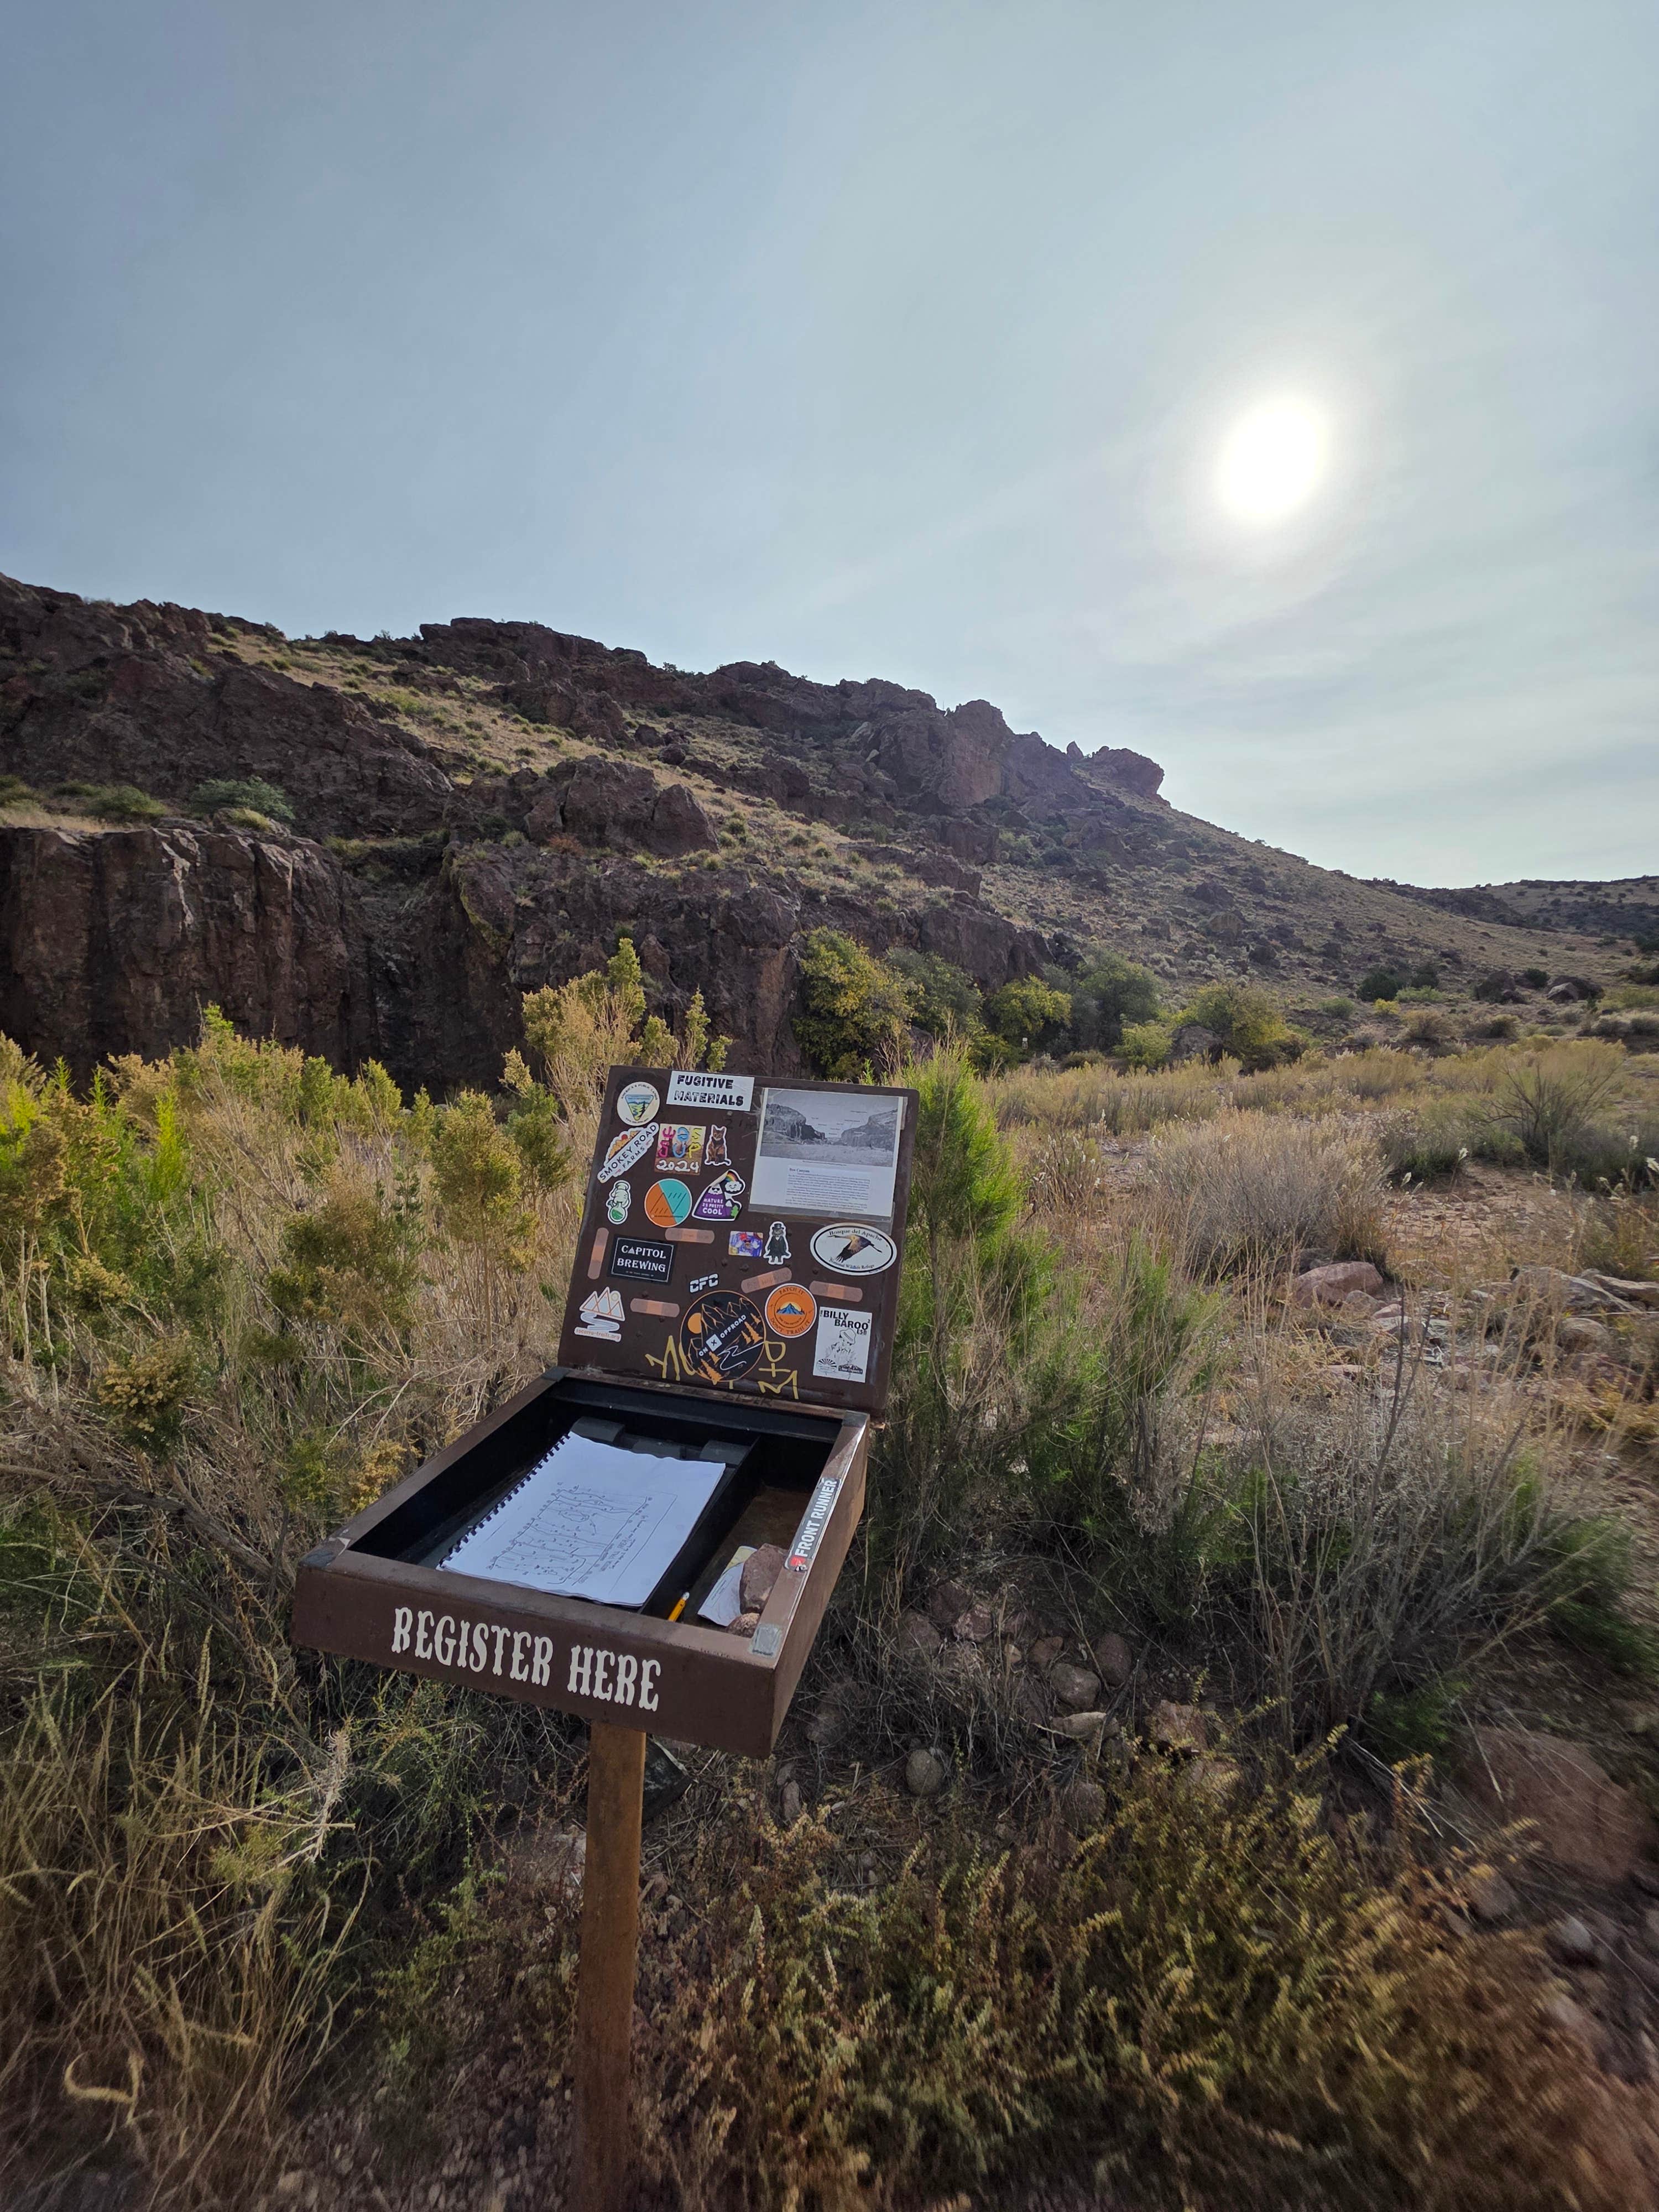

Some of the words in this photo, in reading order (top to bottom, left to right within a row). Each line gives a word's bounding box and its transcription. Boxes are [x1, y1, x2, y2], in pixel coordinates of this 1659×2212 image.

[677, 1075, 733, 1089] FUGITIVE
[674, 1091, 744, 1106] MATERIALS
[600, 1145, 633, 1181] SMOKEY
[635, 1124, 656, 1148] ROAD
[622, 1146, 646, 1168] FARMS
[656, 1159, 700, 1173] 2024
[862, 1231, 883, 1241] Apache
[621, 1245, 666, 1259] CAPITOL
[617, 1258, 666, 1272] BREWING
[690, 1274, 718, 1293] CFC
[823, 1310, 849, 1320] BILLY
[834, 1319, 869, 1330] BAROO
[698, 1347, 708, 1357] ON
[720, 1314, 747, 1339] OFFROAD
[795, 1520, 821, 1557] FRONT
[811, 1480, 837, 1519] RUNNER
[391, 1607, 554, 1687] REGISTER
[567, 1645, 661, 1712] HERE
